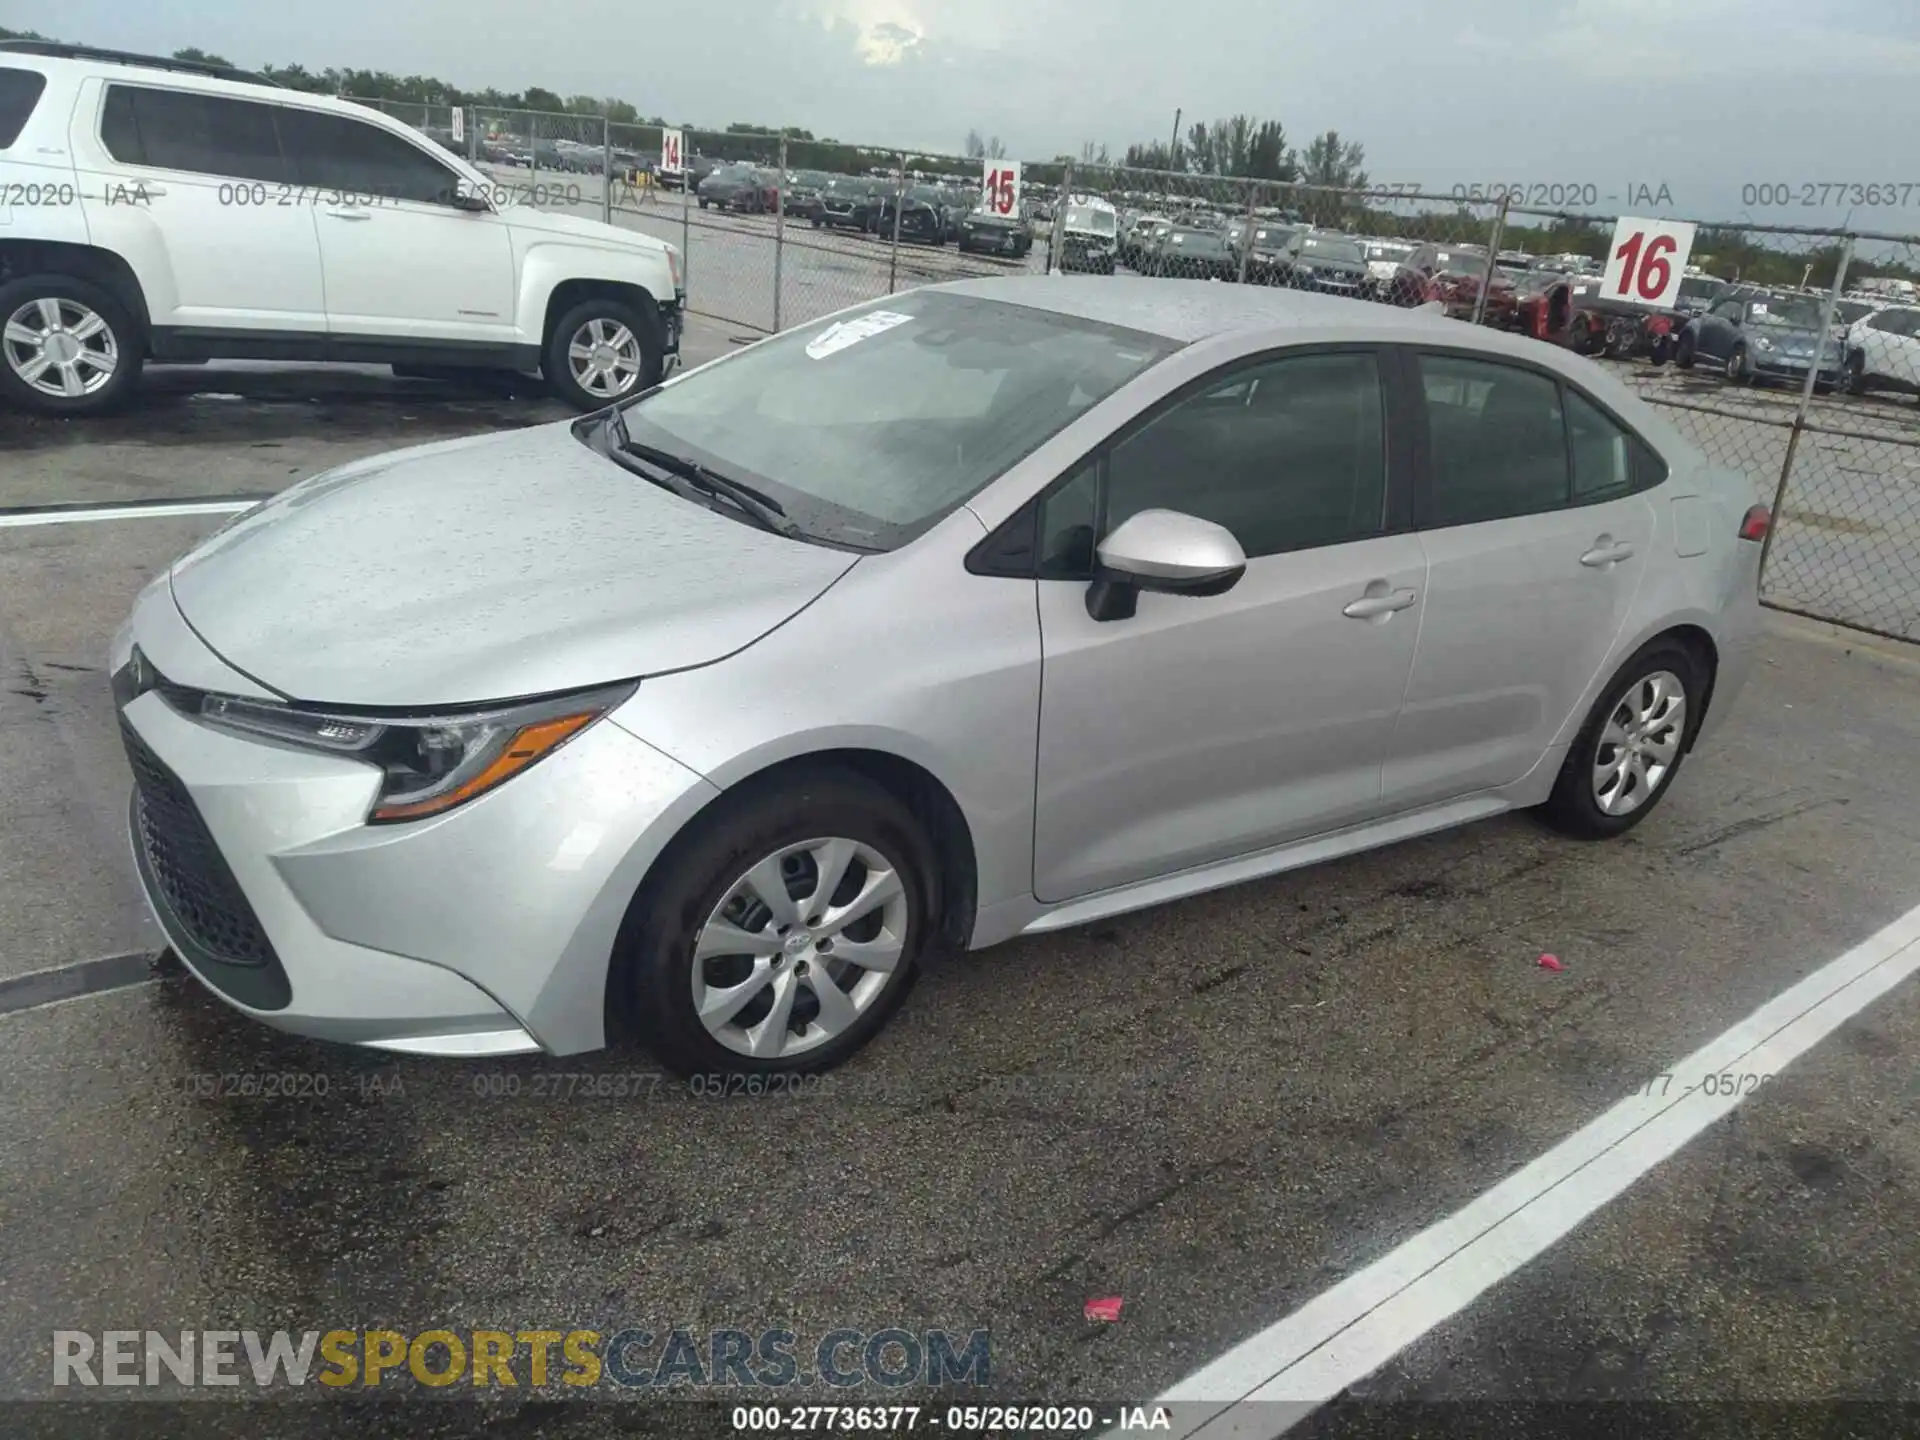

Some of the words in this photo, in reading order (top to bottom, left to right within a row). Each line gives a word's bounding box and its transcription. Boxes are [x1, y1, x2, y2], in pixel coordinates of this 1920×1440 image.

[665, 135, 679, 170] 14
[987, 168, 1015, 214] 15
[1616, 231, 1677, 300] 16
